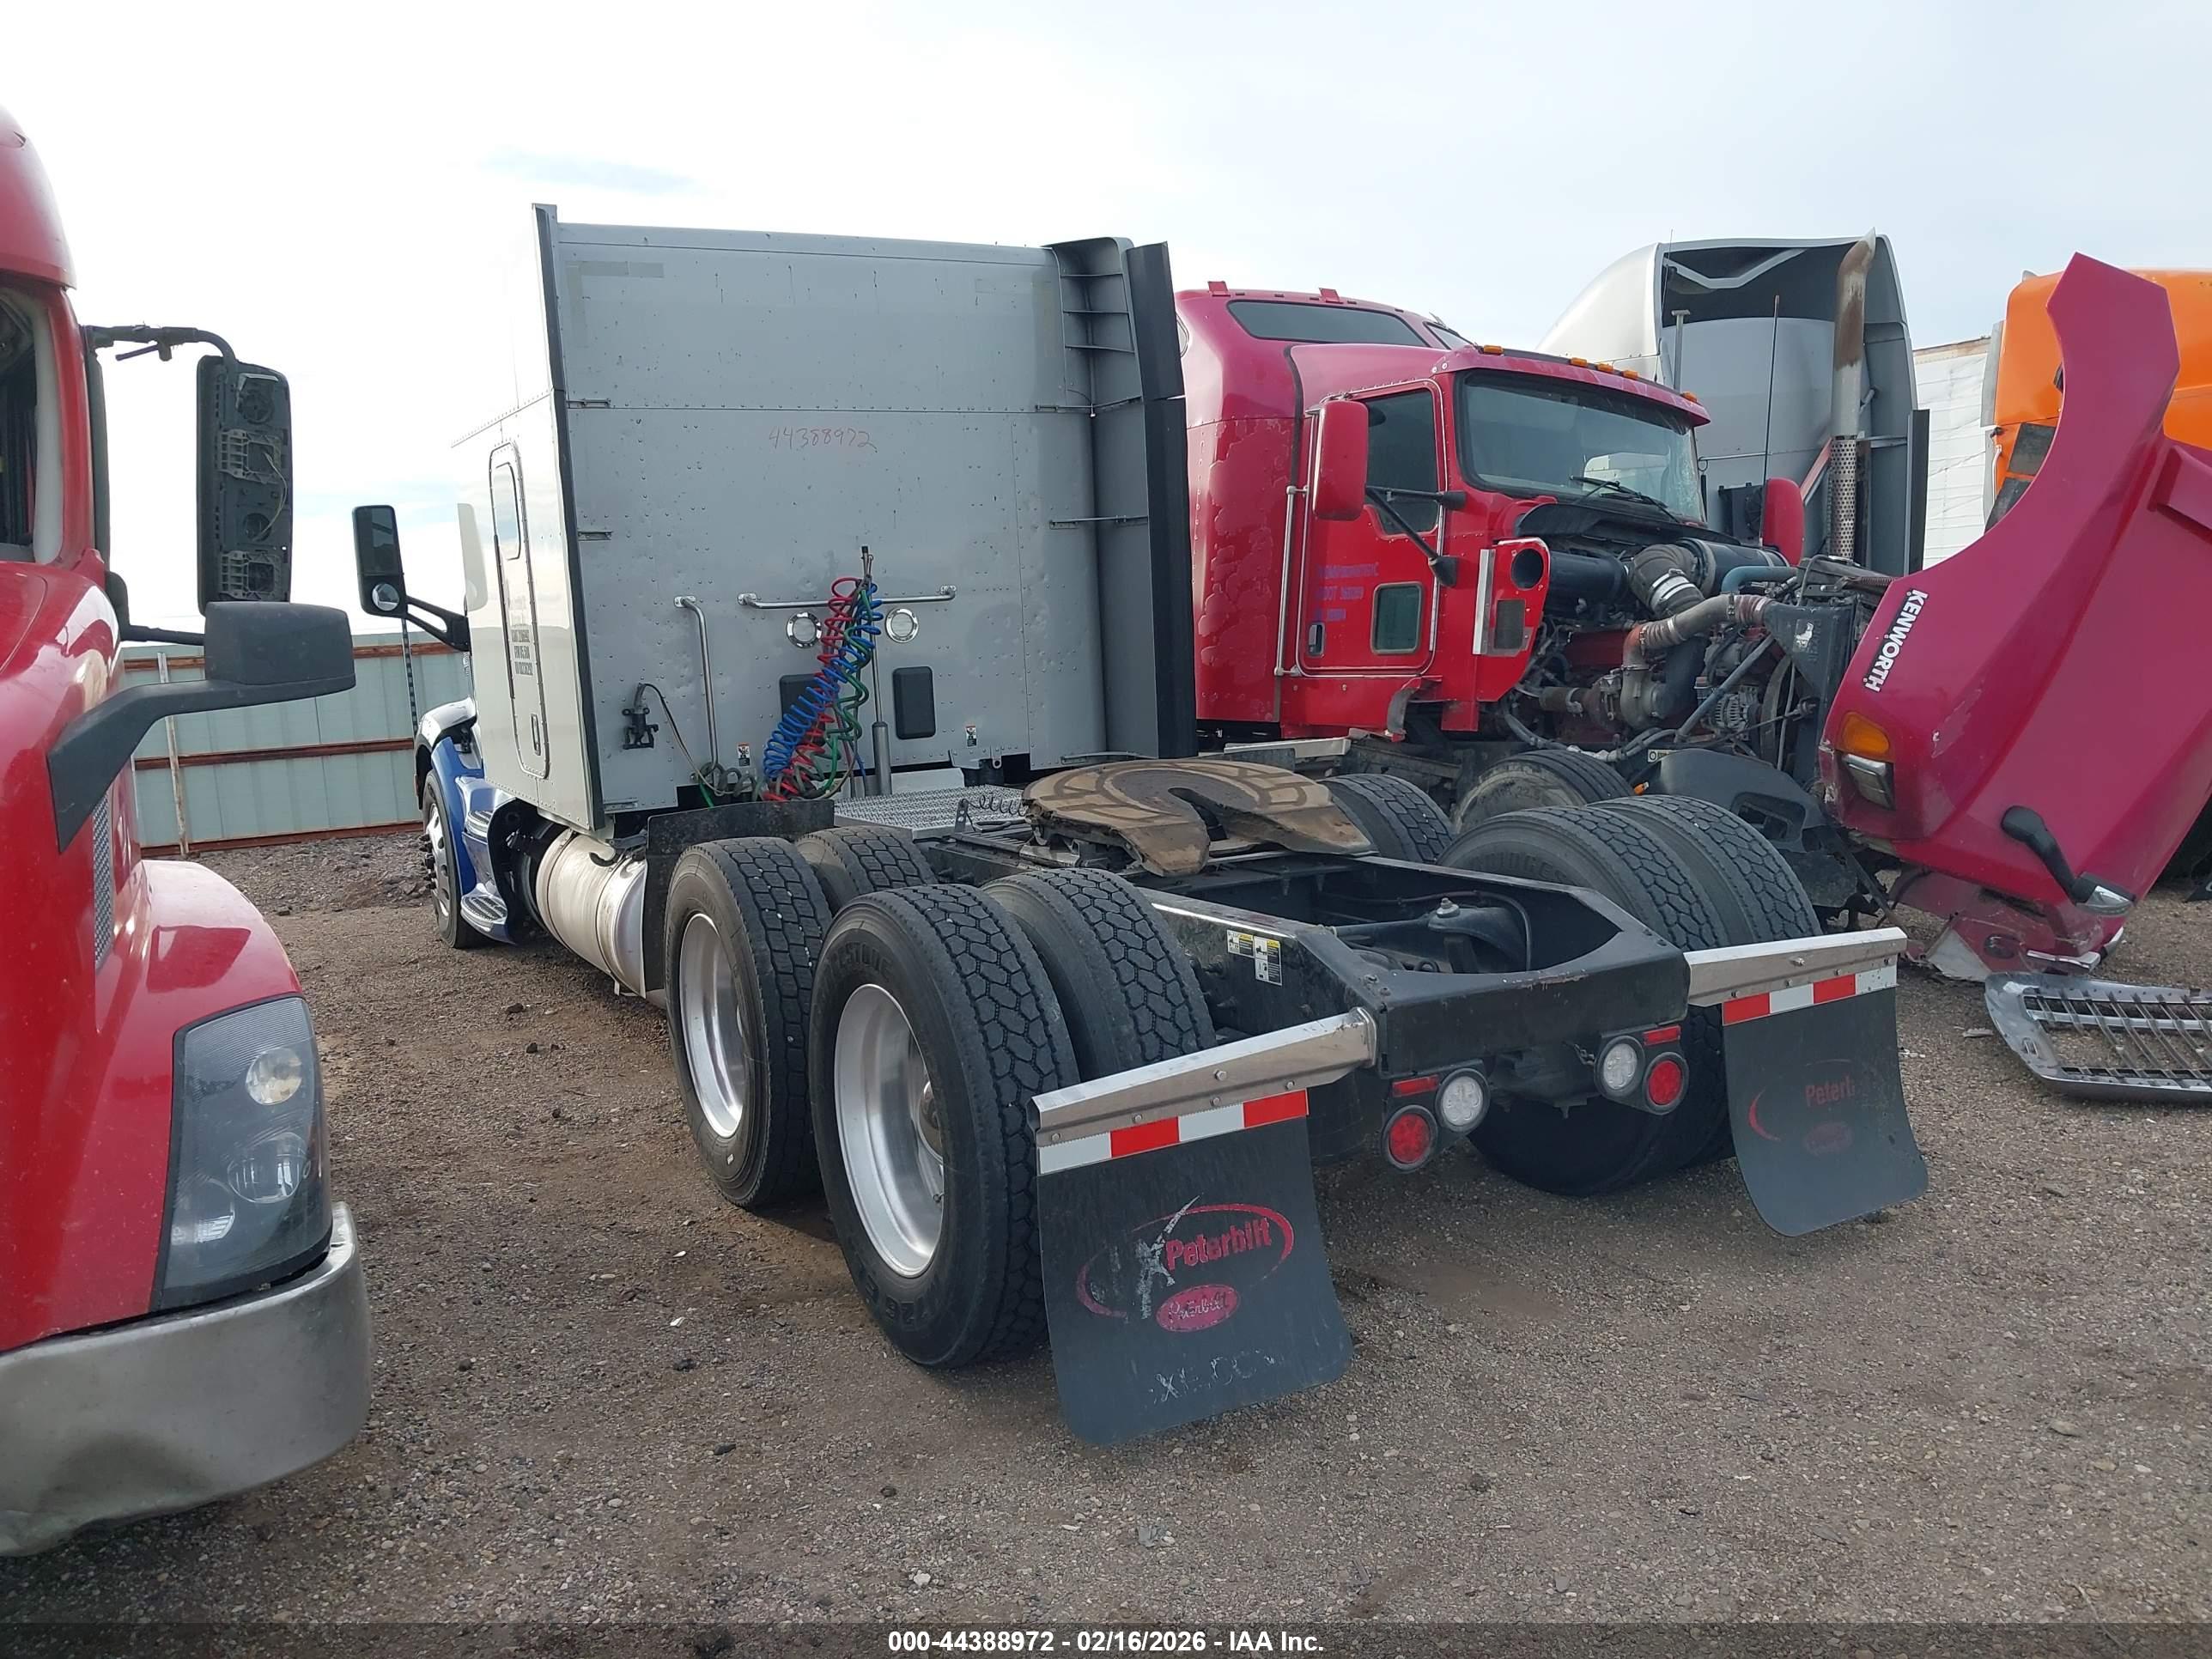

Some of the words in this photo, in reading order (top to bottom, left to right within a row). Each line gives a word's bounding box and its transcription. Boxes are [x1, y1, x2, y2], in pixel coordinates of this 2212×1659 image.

[769, 425, 878, 453] 44388972
[1864, 589, 1929, 692] KENWORTH
[1164, 1216, 1273, 1272] Peterbilt
